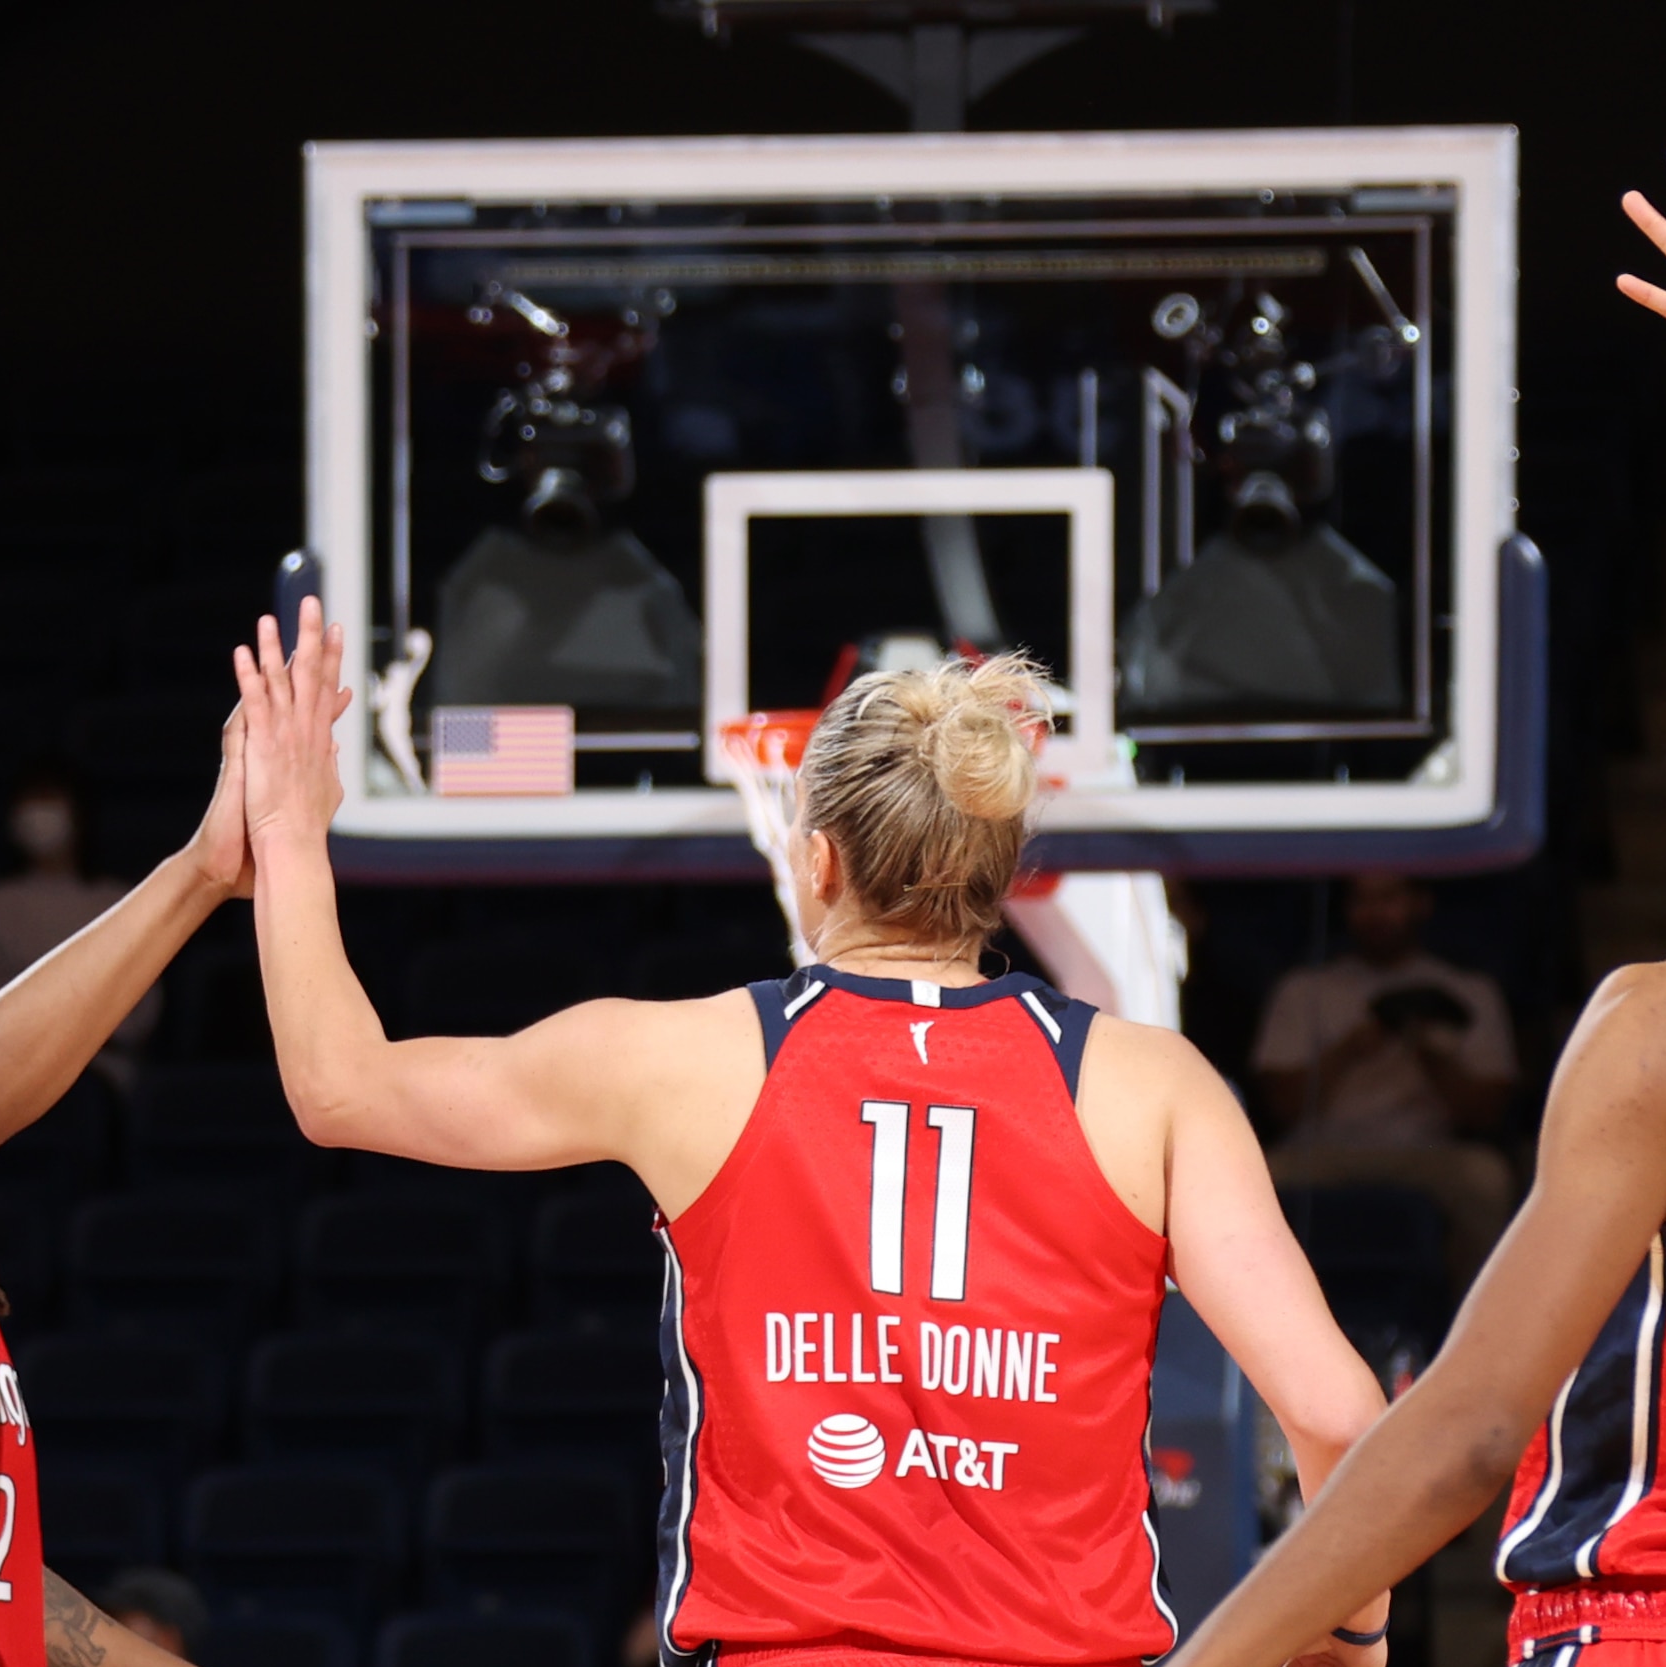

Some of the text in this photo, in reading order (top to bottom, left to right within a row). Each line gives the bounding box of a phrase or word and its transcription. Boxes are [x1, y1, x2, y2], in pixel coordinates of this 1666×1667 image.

[861, 1099, 978, 1302] 11
[765, 1312, 1060, 1403] DELLE DONNE
[895, 1429, 1019, 1491] AT&T
